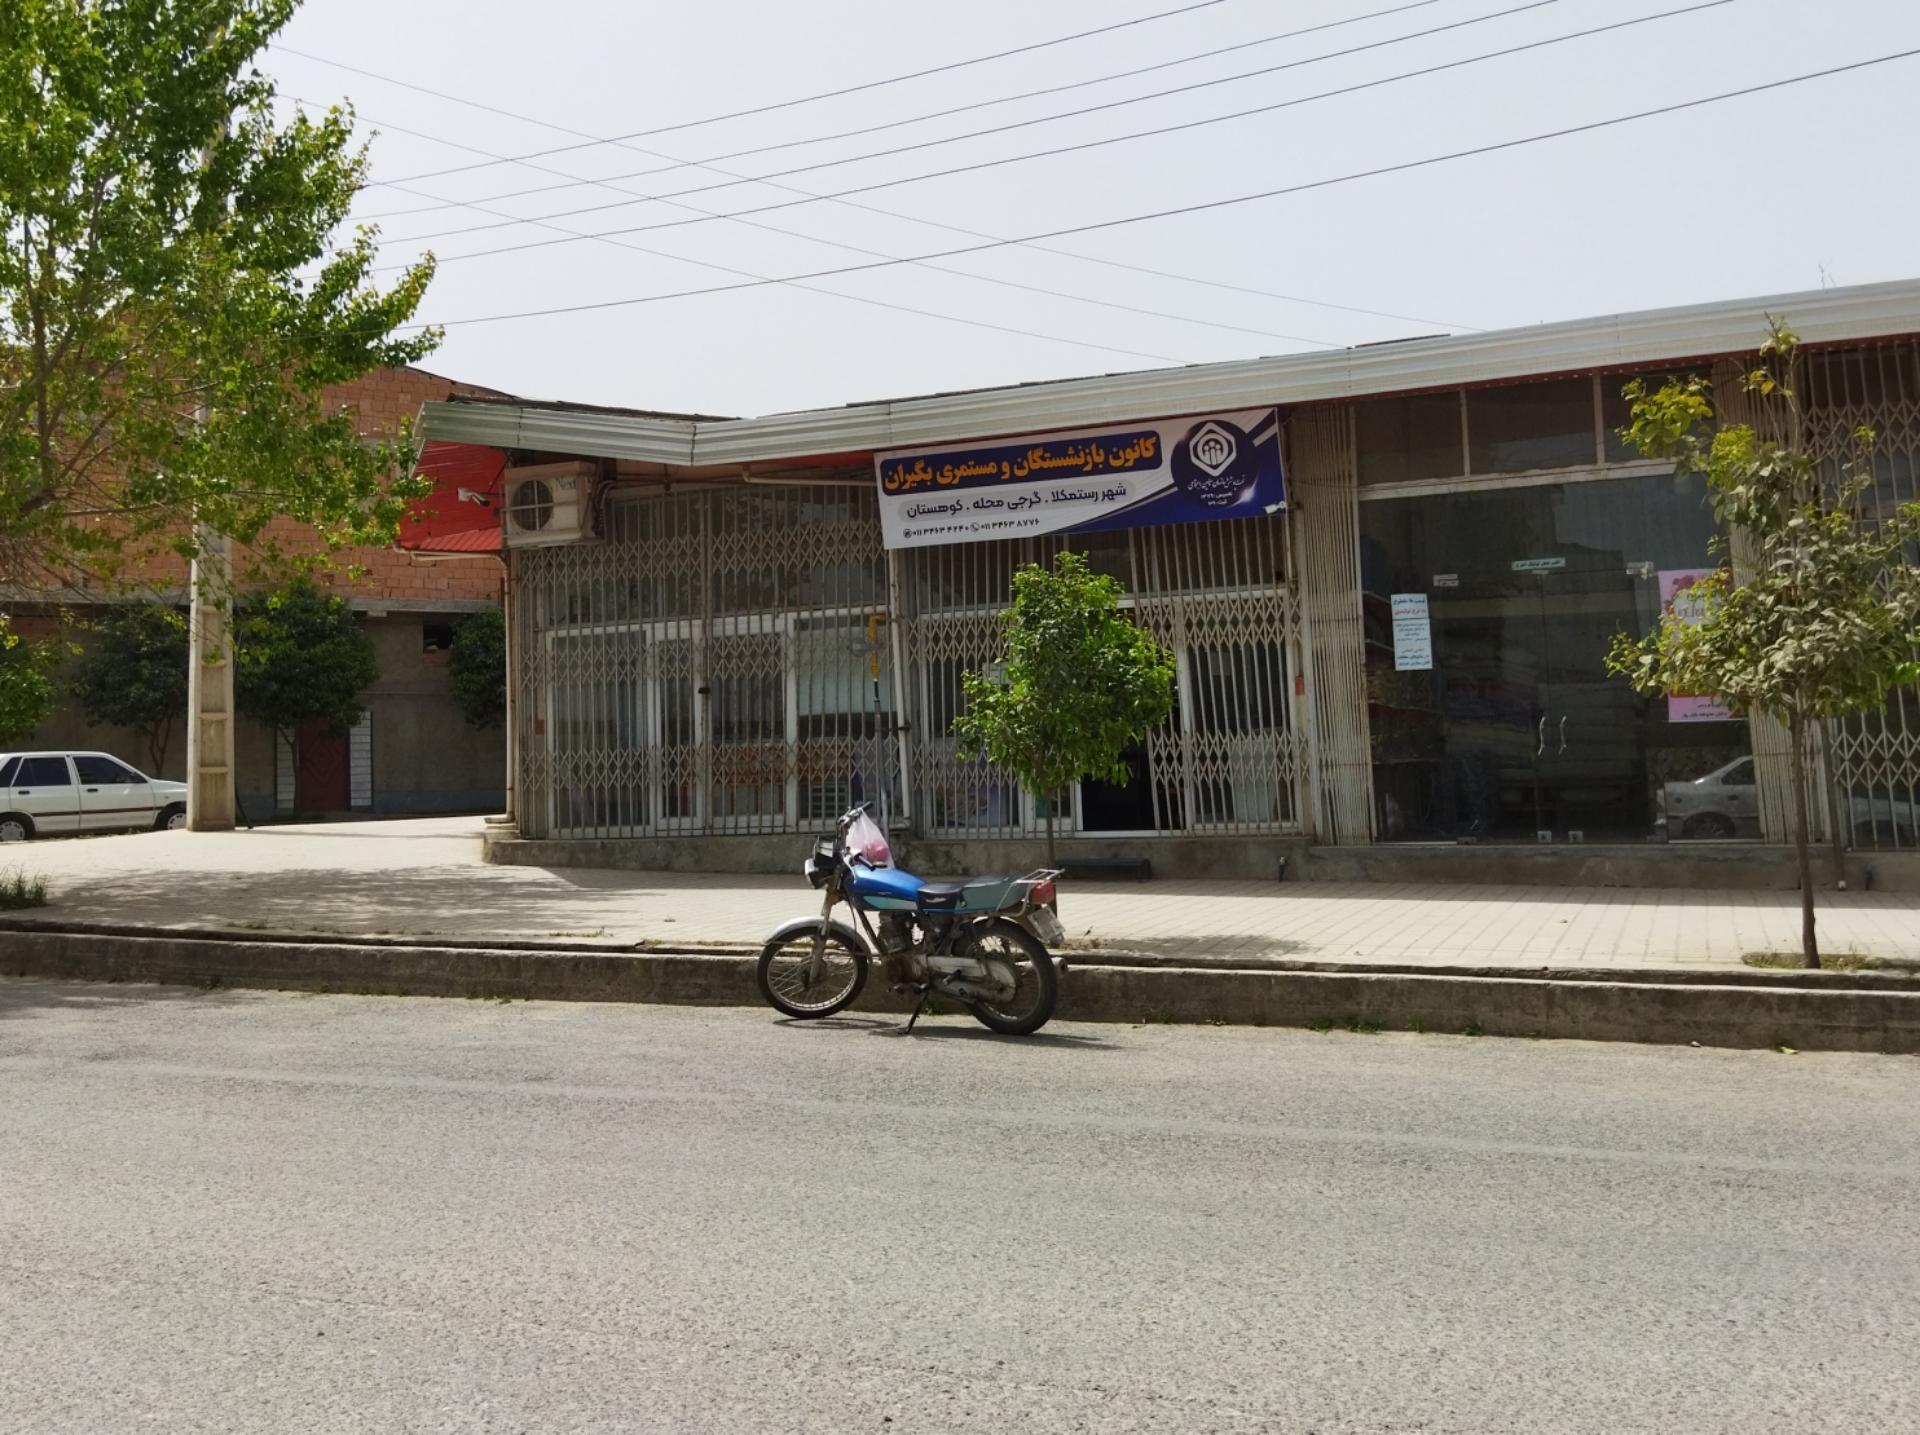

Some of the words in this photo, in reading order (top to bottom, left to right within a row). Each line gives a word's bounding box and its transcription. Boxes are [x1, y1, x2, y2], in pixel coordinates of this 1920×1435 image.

[1013, 442, 1105, 477] بازنشستگان
[1109, 436, 1157, 468] کانون
[884, 459, 933, 490] بگیران
[936, 460, 998, 485] مستمری
[1000, 460, 1011, 480] و
[1007, 491, 1041, 510] گرجی
[1051, 487, 1098, 503] رستمکلا
[1101, 482, 1127, 502] شهر
[906, 499, 963, 519] کوهستان
[972, 496, 1004, 510] محله
